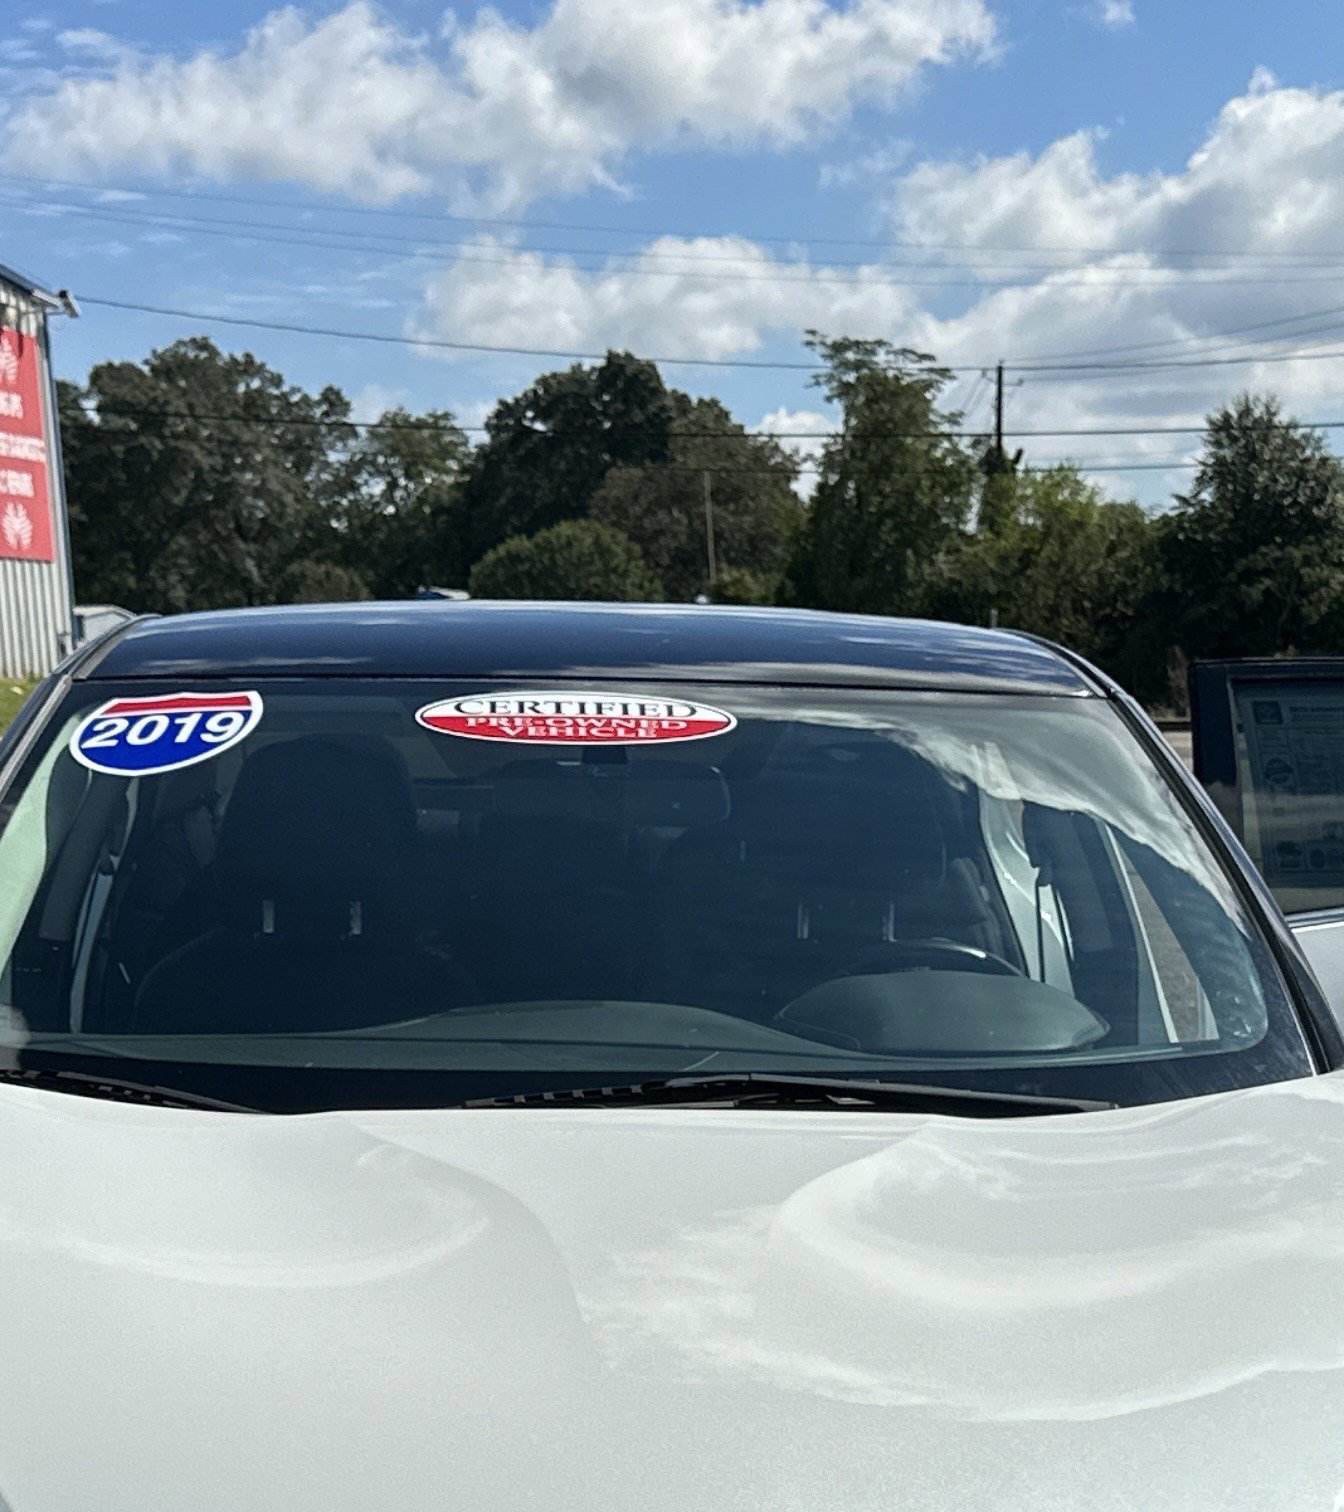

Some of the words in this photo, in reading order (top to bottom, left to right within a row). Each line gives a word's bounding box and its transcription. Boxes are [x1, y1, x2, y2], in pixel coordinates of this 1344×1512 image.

[455, 700, 697, 718] CERTIFIED
[81, 711, 245, 750] 2019
[466, 717, 688, 730] PRE-OWNED
[499, 726, 658, 738] VEHICLE
